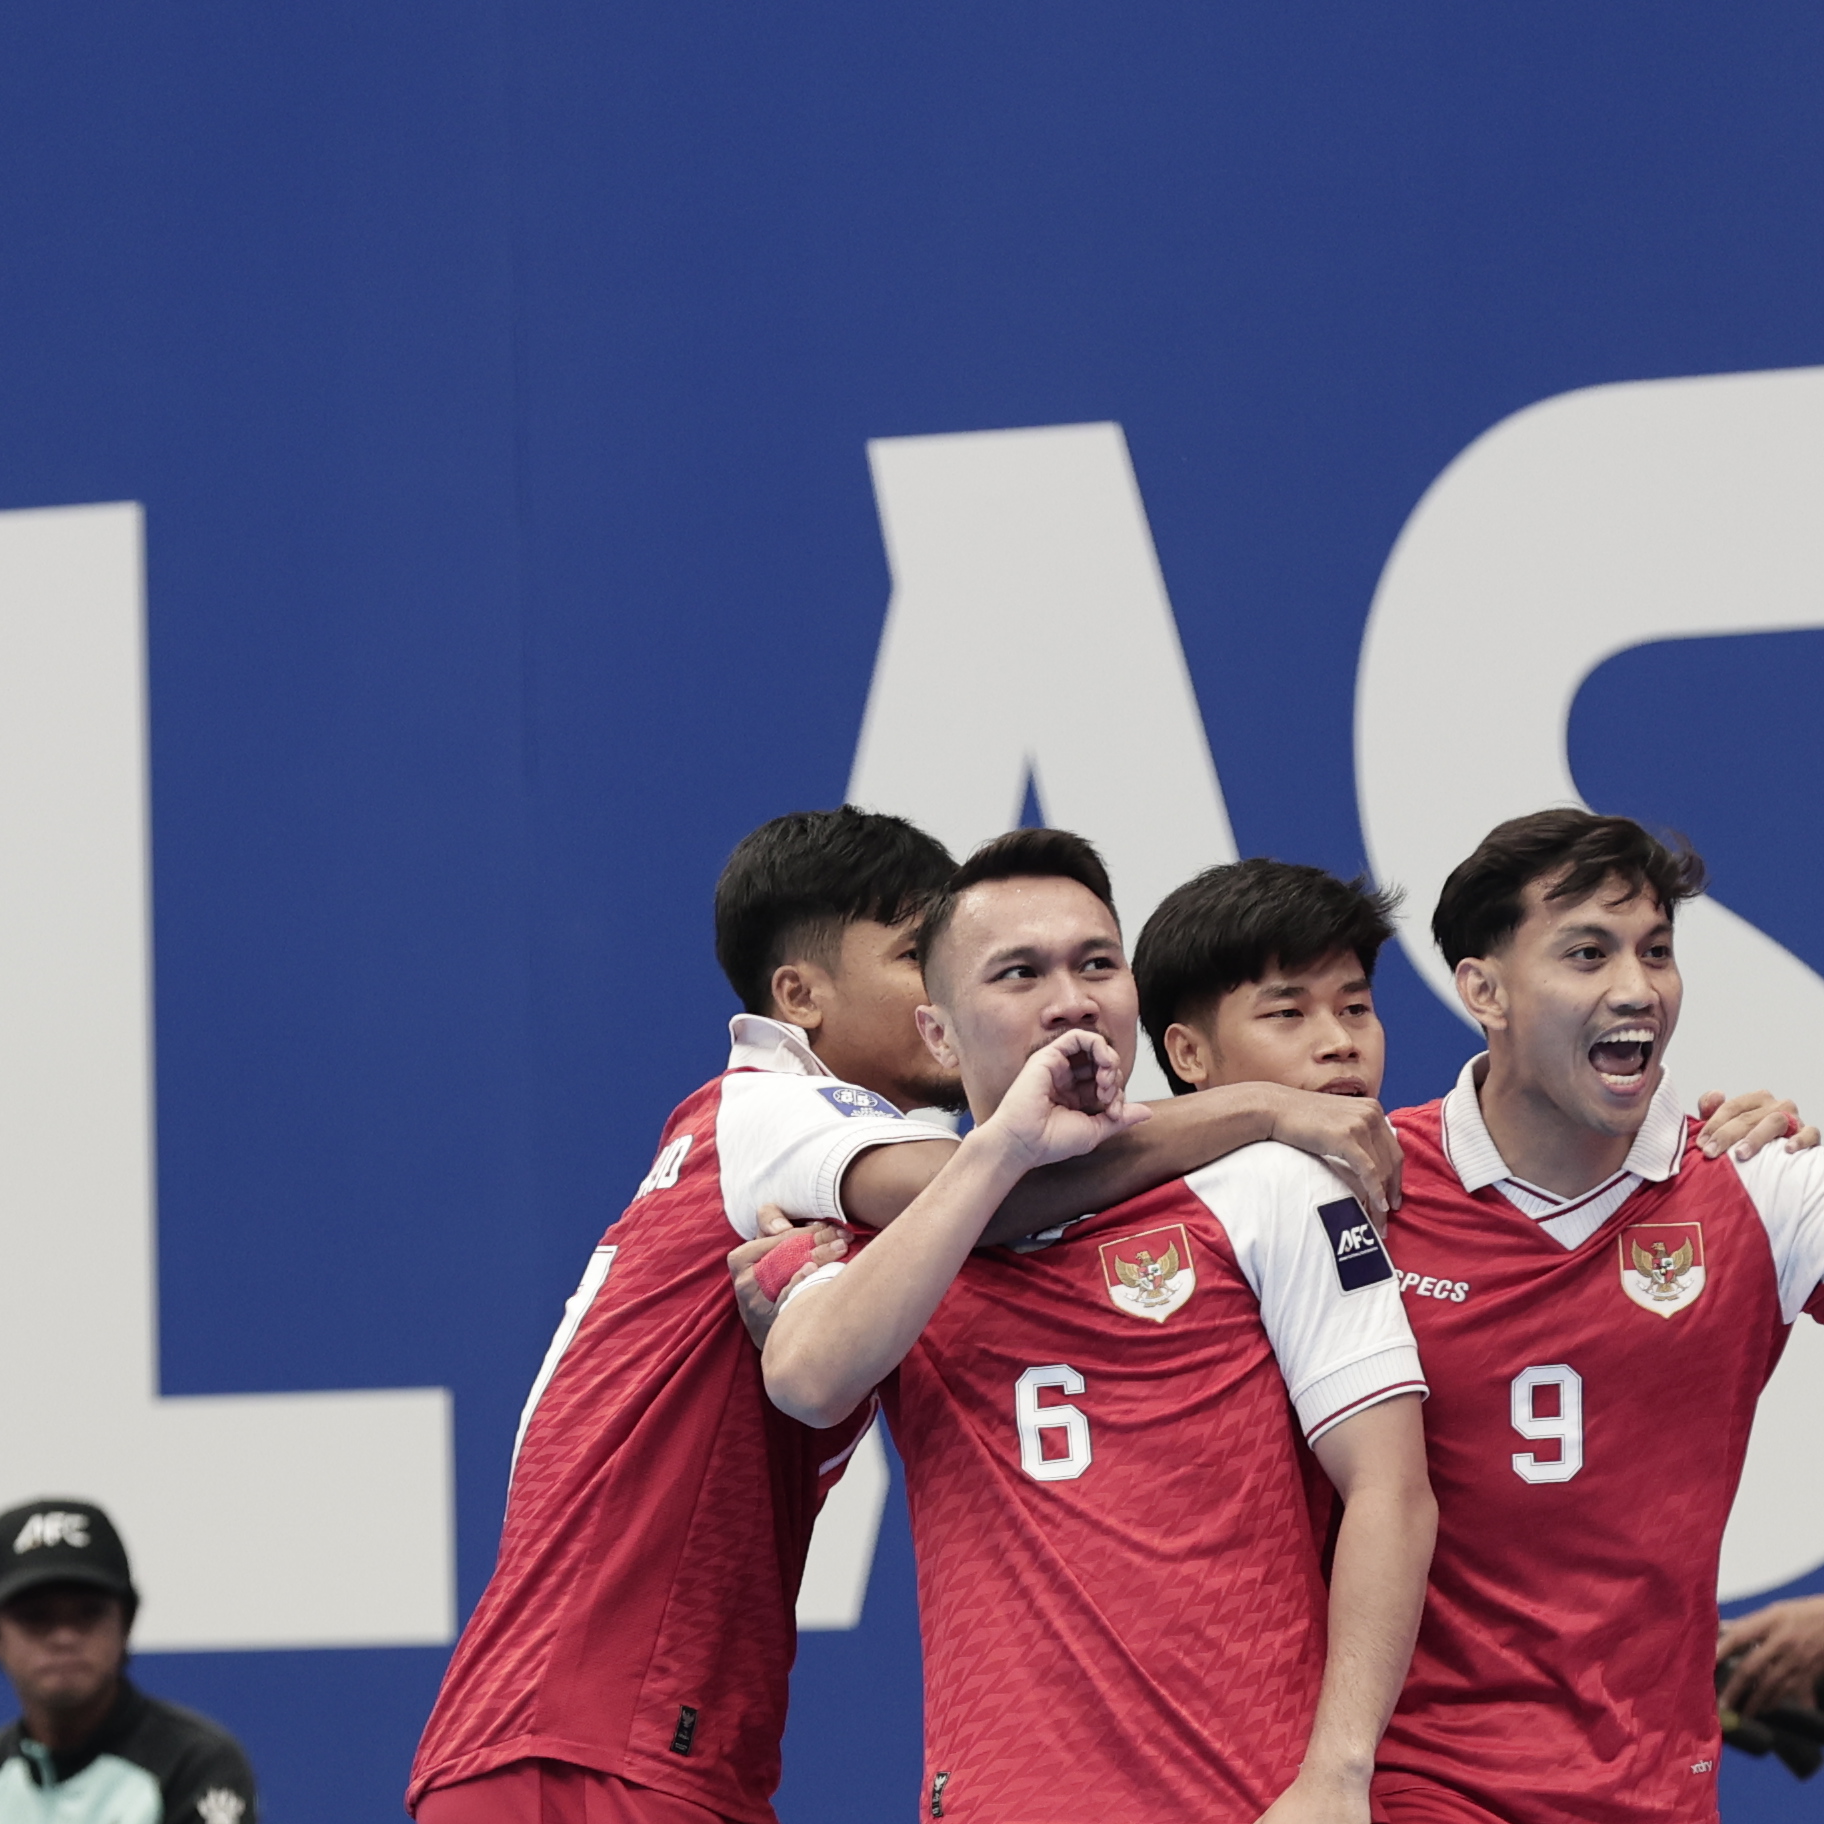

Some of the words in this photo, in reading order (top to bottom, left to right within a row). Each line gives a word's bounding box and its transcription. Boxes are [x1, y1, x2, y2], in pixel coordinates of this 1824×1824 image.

[1337, 1223, 1375, 1256] AFC
[1015, 1363, 1092, 1482] 6
[1511, 1364, 1584, 1484] 9
[13, 1510, 92, 1554] AFC
